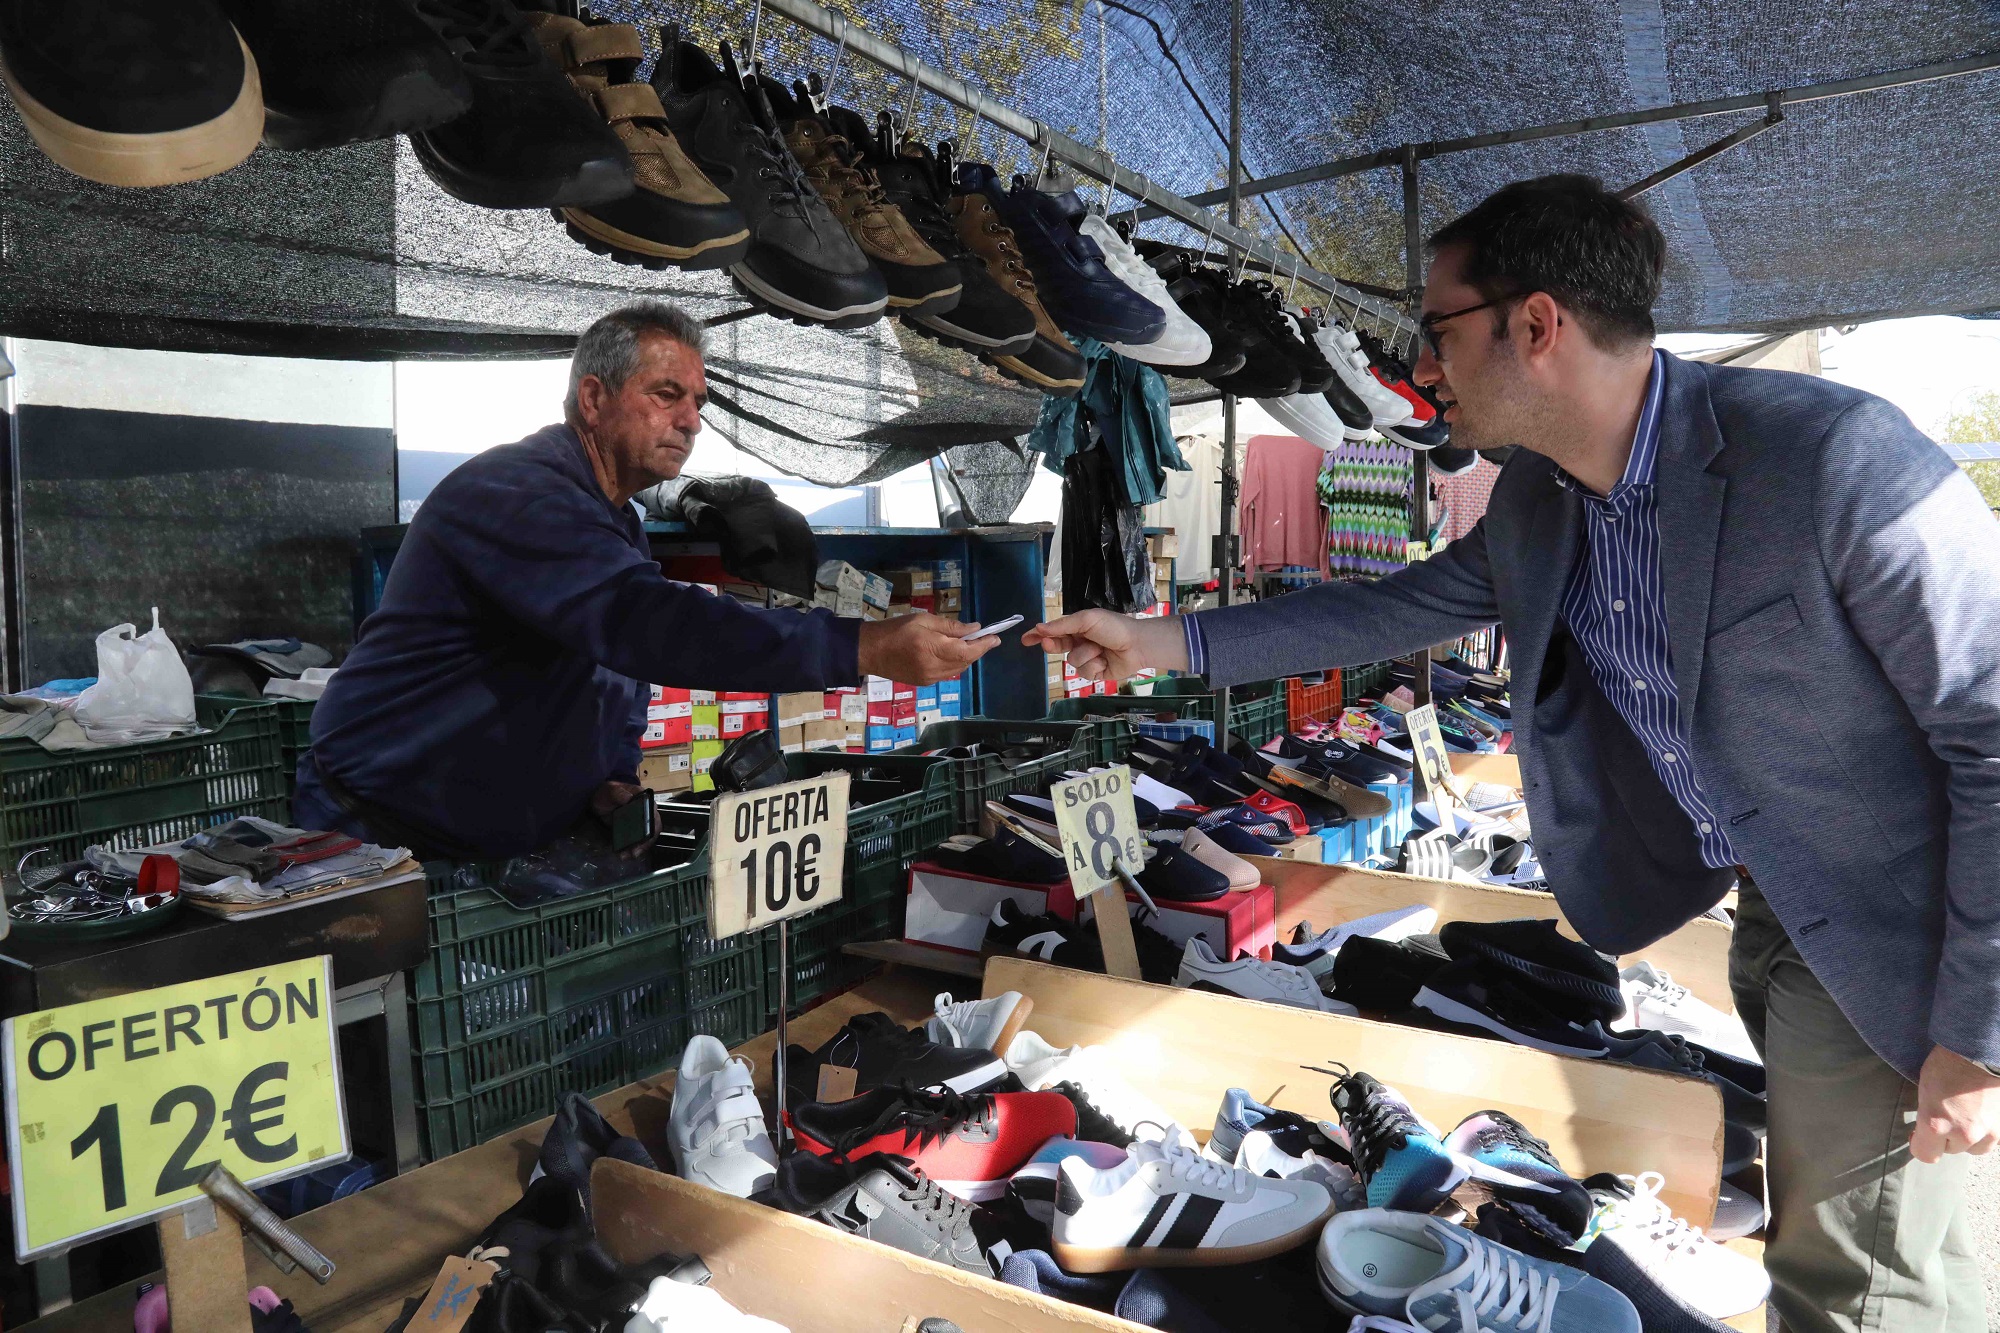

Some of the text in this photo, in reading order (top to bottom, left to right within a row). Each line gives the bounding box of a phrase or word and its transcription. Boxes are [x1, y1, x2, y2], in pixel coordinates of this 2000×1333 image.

[1409, 708, 1435, 730] OFERTA
[734, 785, 829, 842] OFERTA
[1064, 774, 1121, 808] SOLO
[740, 833, 821, 919] 10€
[1072, 841, 1088, 872] A
[28, 976, 319, 1081] OFERTÓN
[70, 1061, 299, 1213] 12€
